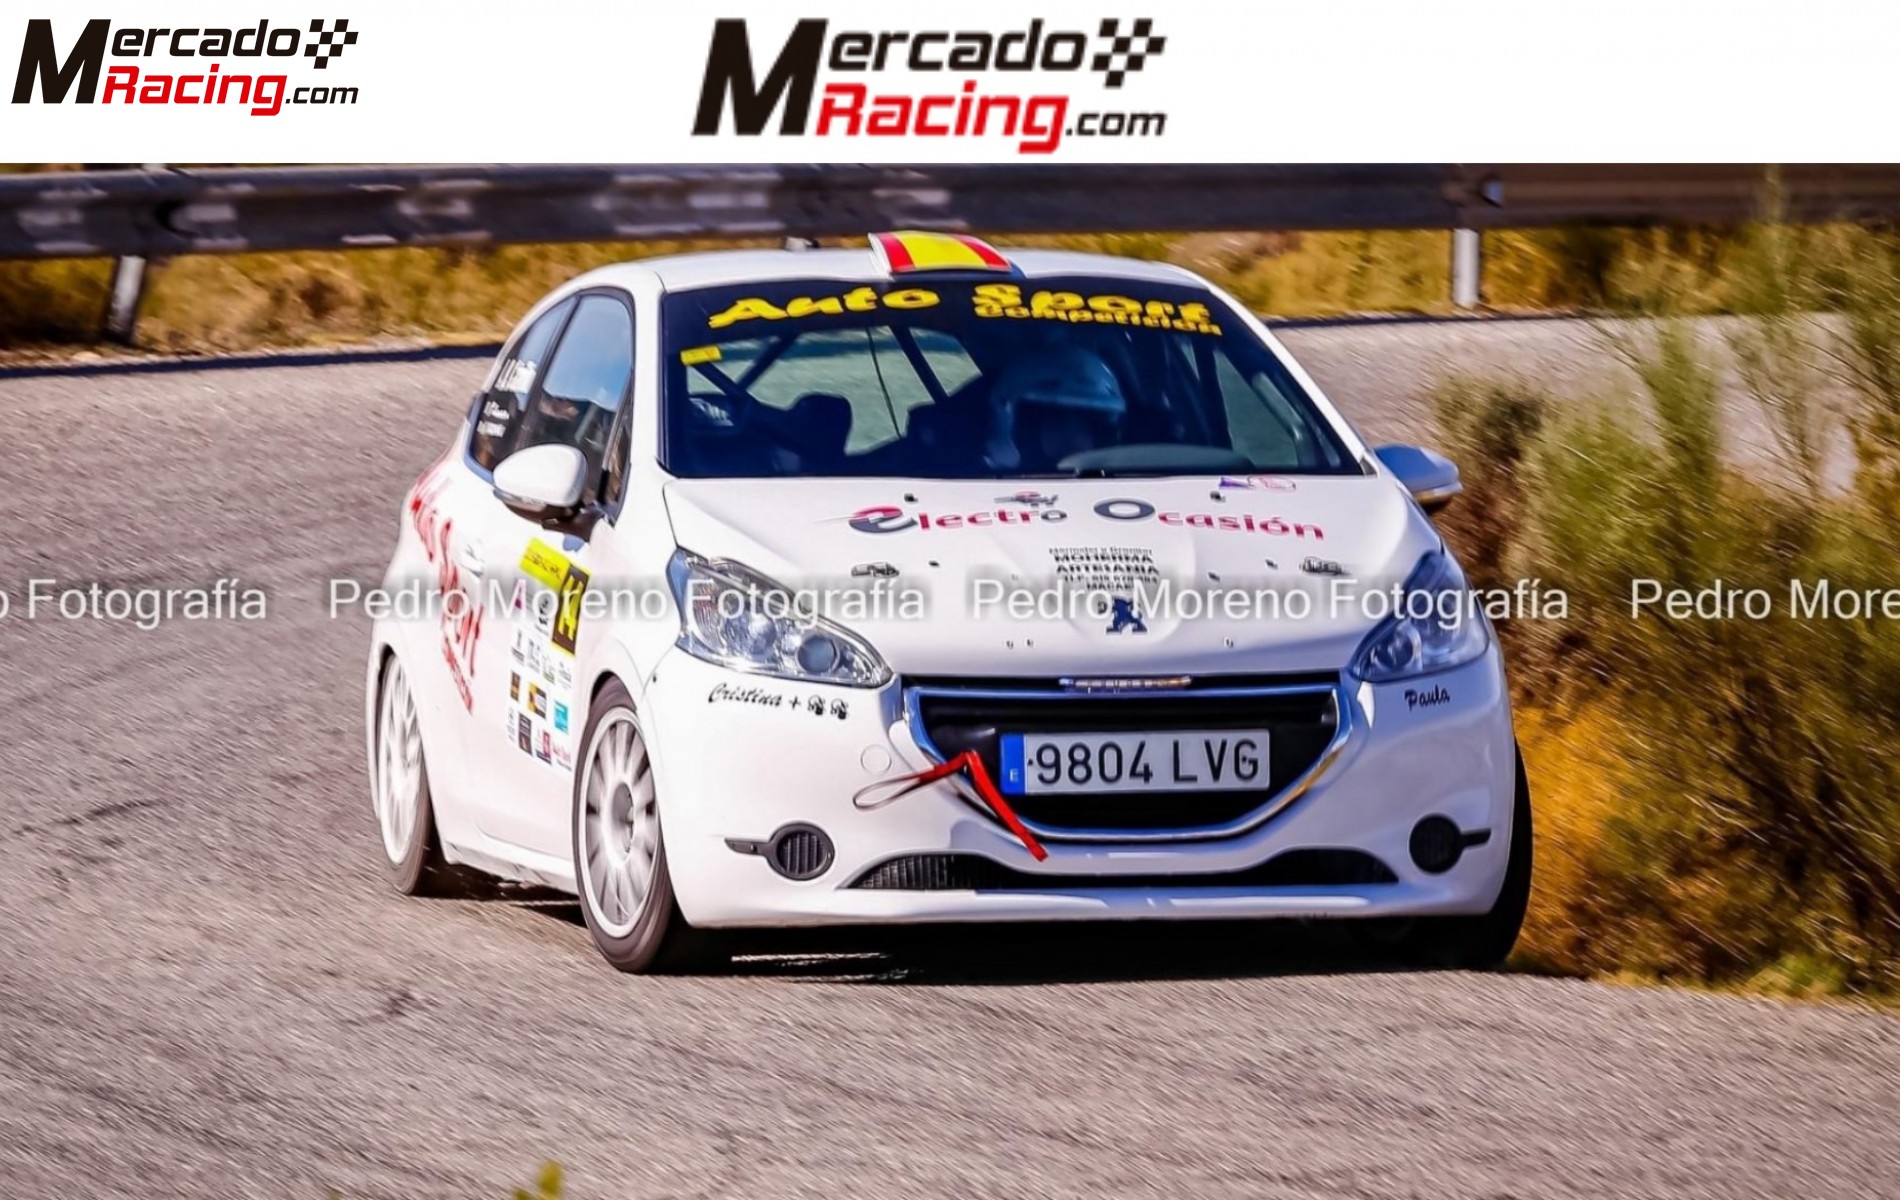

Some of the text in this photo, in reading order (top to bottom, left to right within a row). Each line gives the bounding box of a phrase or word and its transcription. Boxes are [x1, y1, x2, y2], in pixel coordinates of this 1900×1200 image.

[707, 283, 1211, 329] Auto Sport
[1092, 497, 1325, 541] Ocasión
[707, 682, 783, 708] Cristina
[1404, 683, 1451, 712] Paula
[1035, 738, 1259, 785] 9804 LVG
